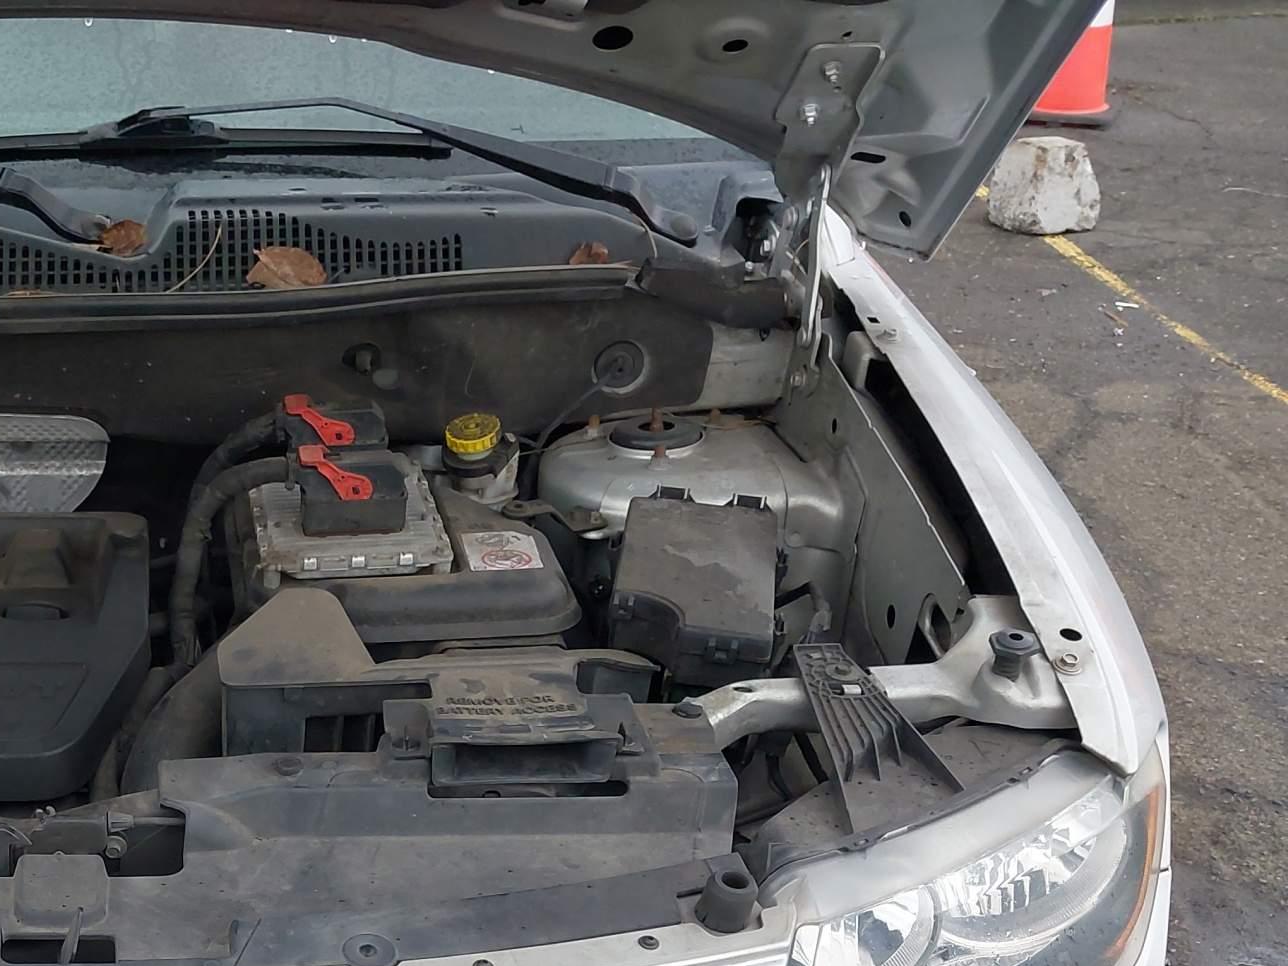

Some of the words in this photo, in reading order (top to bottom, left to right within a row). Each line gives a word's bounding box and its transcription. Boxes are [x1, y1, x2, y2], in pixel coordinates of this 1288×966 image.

[445, 696, 516, 706] REMOVE
[518, 695, 555, 704] FOR
[436, 706, 503, 716] BATTERY
[510, 703, 578, 715] ACCESS
